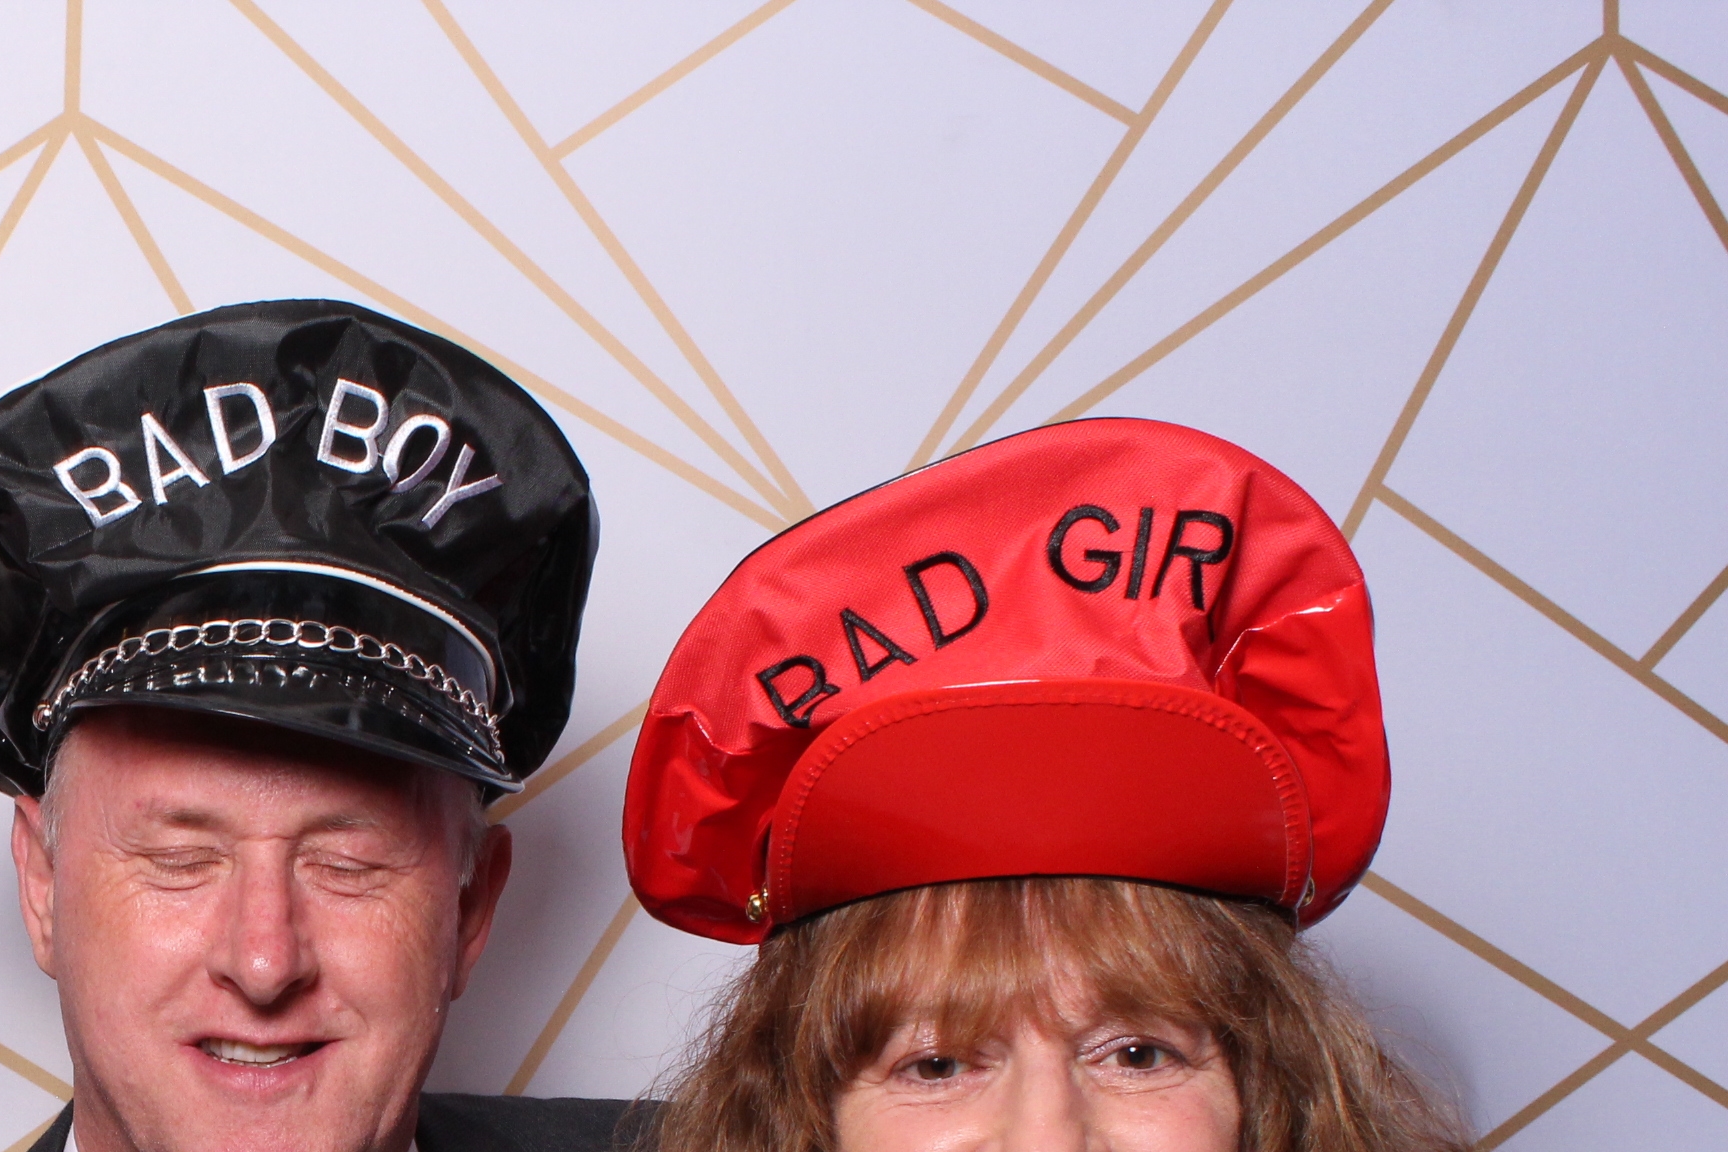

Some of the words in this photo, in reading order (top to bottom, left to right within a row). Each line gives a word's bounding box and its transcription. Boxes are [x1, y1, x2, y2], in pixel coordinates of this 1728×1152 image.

[53, 381, 277, 528] BAD
[317, 377, 503, 530] BOY
[756, 550, 989, 728] BAD
[1046, 503, 1234, 644] GIR
